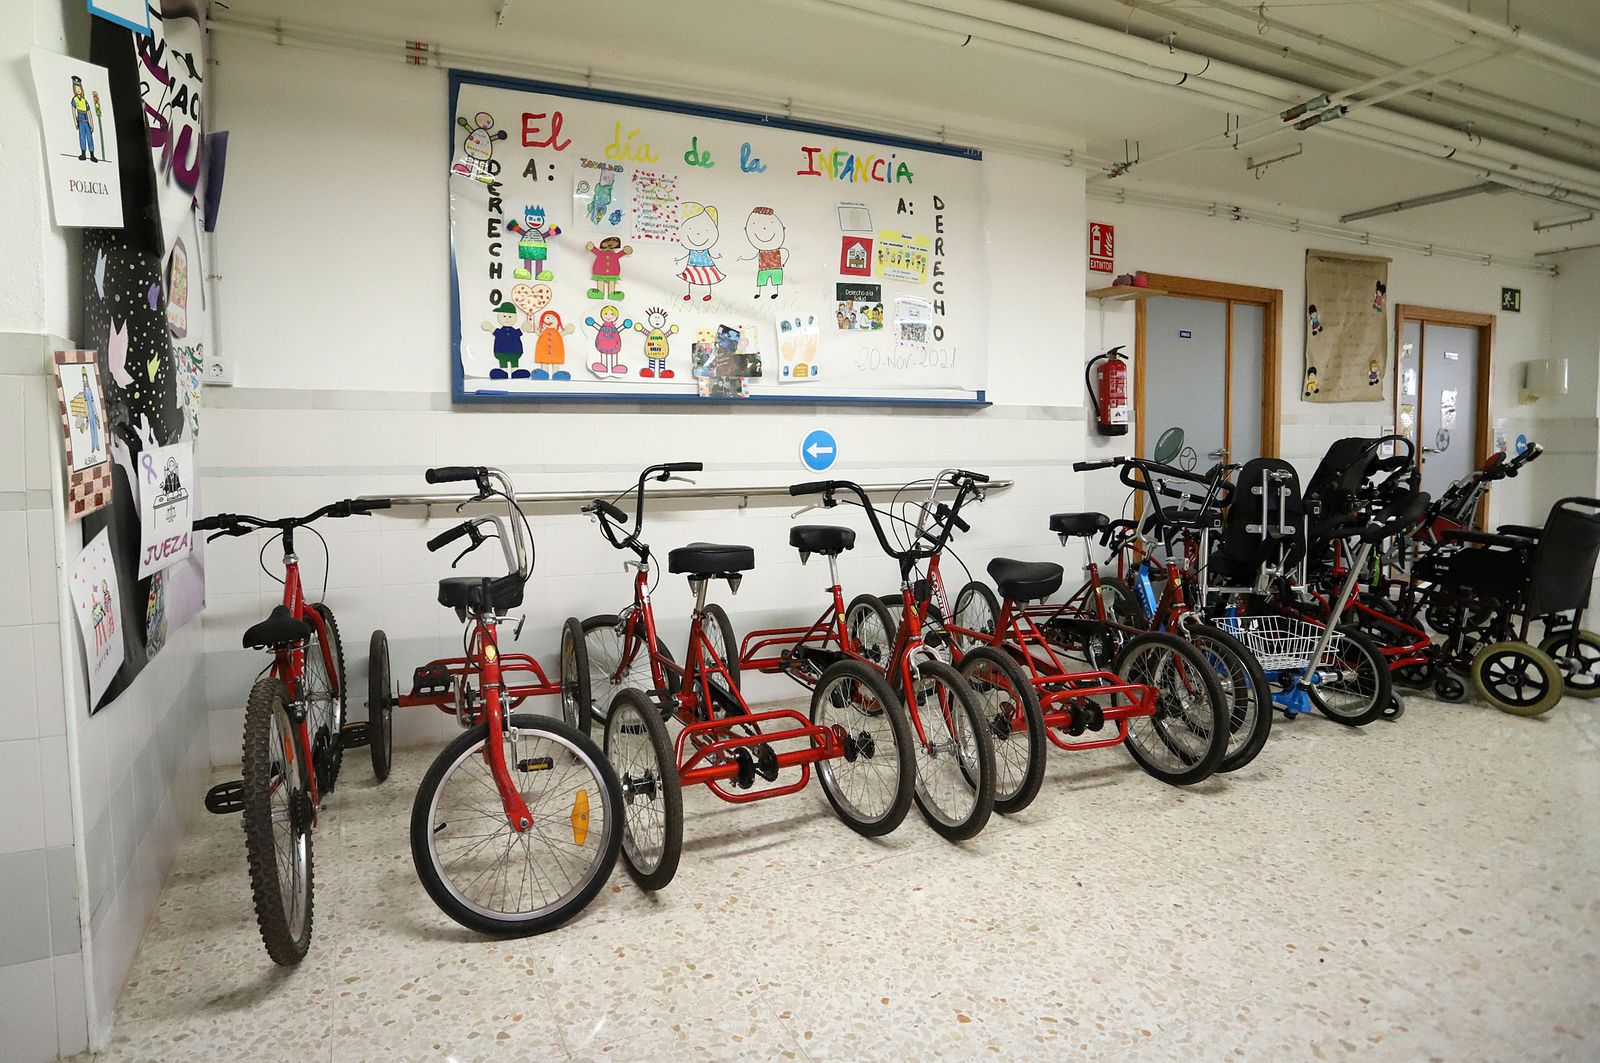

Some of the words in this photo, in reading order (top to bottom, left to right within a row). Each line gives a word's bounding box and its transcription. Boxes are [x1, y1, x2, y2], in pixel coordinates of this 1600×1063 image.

[521, 111, 572, 152] El
[604, 120, 660, 163] día
[684, 136, 715, 168] de
[740, 142, 768, 174] la
[522, 158, 556, 183] A:
[69, 179, 109, 196] POLICIA
[896, 197, 915, 216] A:
[486, 159, 504, 306] DERECHO
[932, 194, 946, 342] DERECHO
[1090, 259, 1113, 272] EXTINTOR
[143, 532, 189, 566] JUEZA
